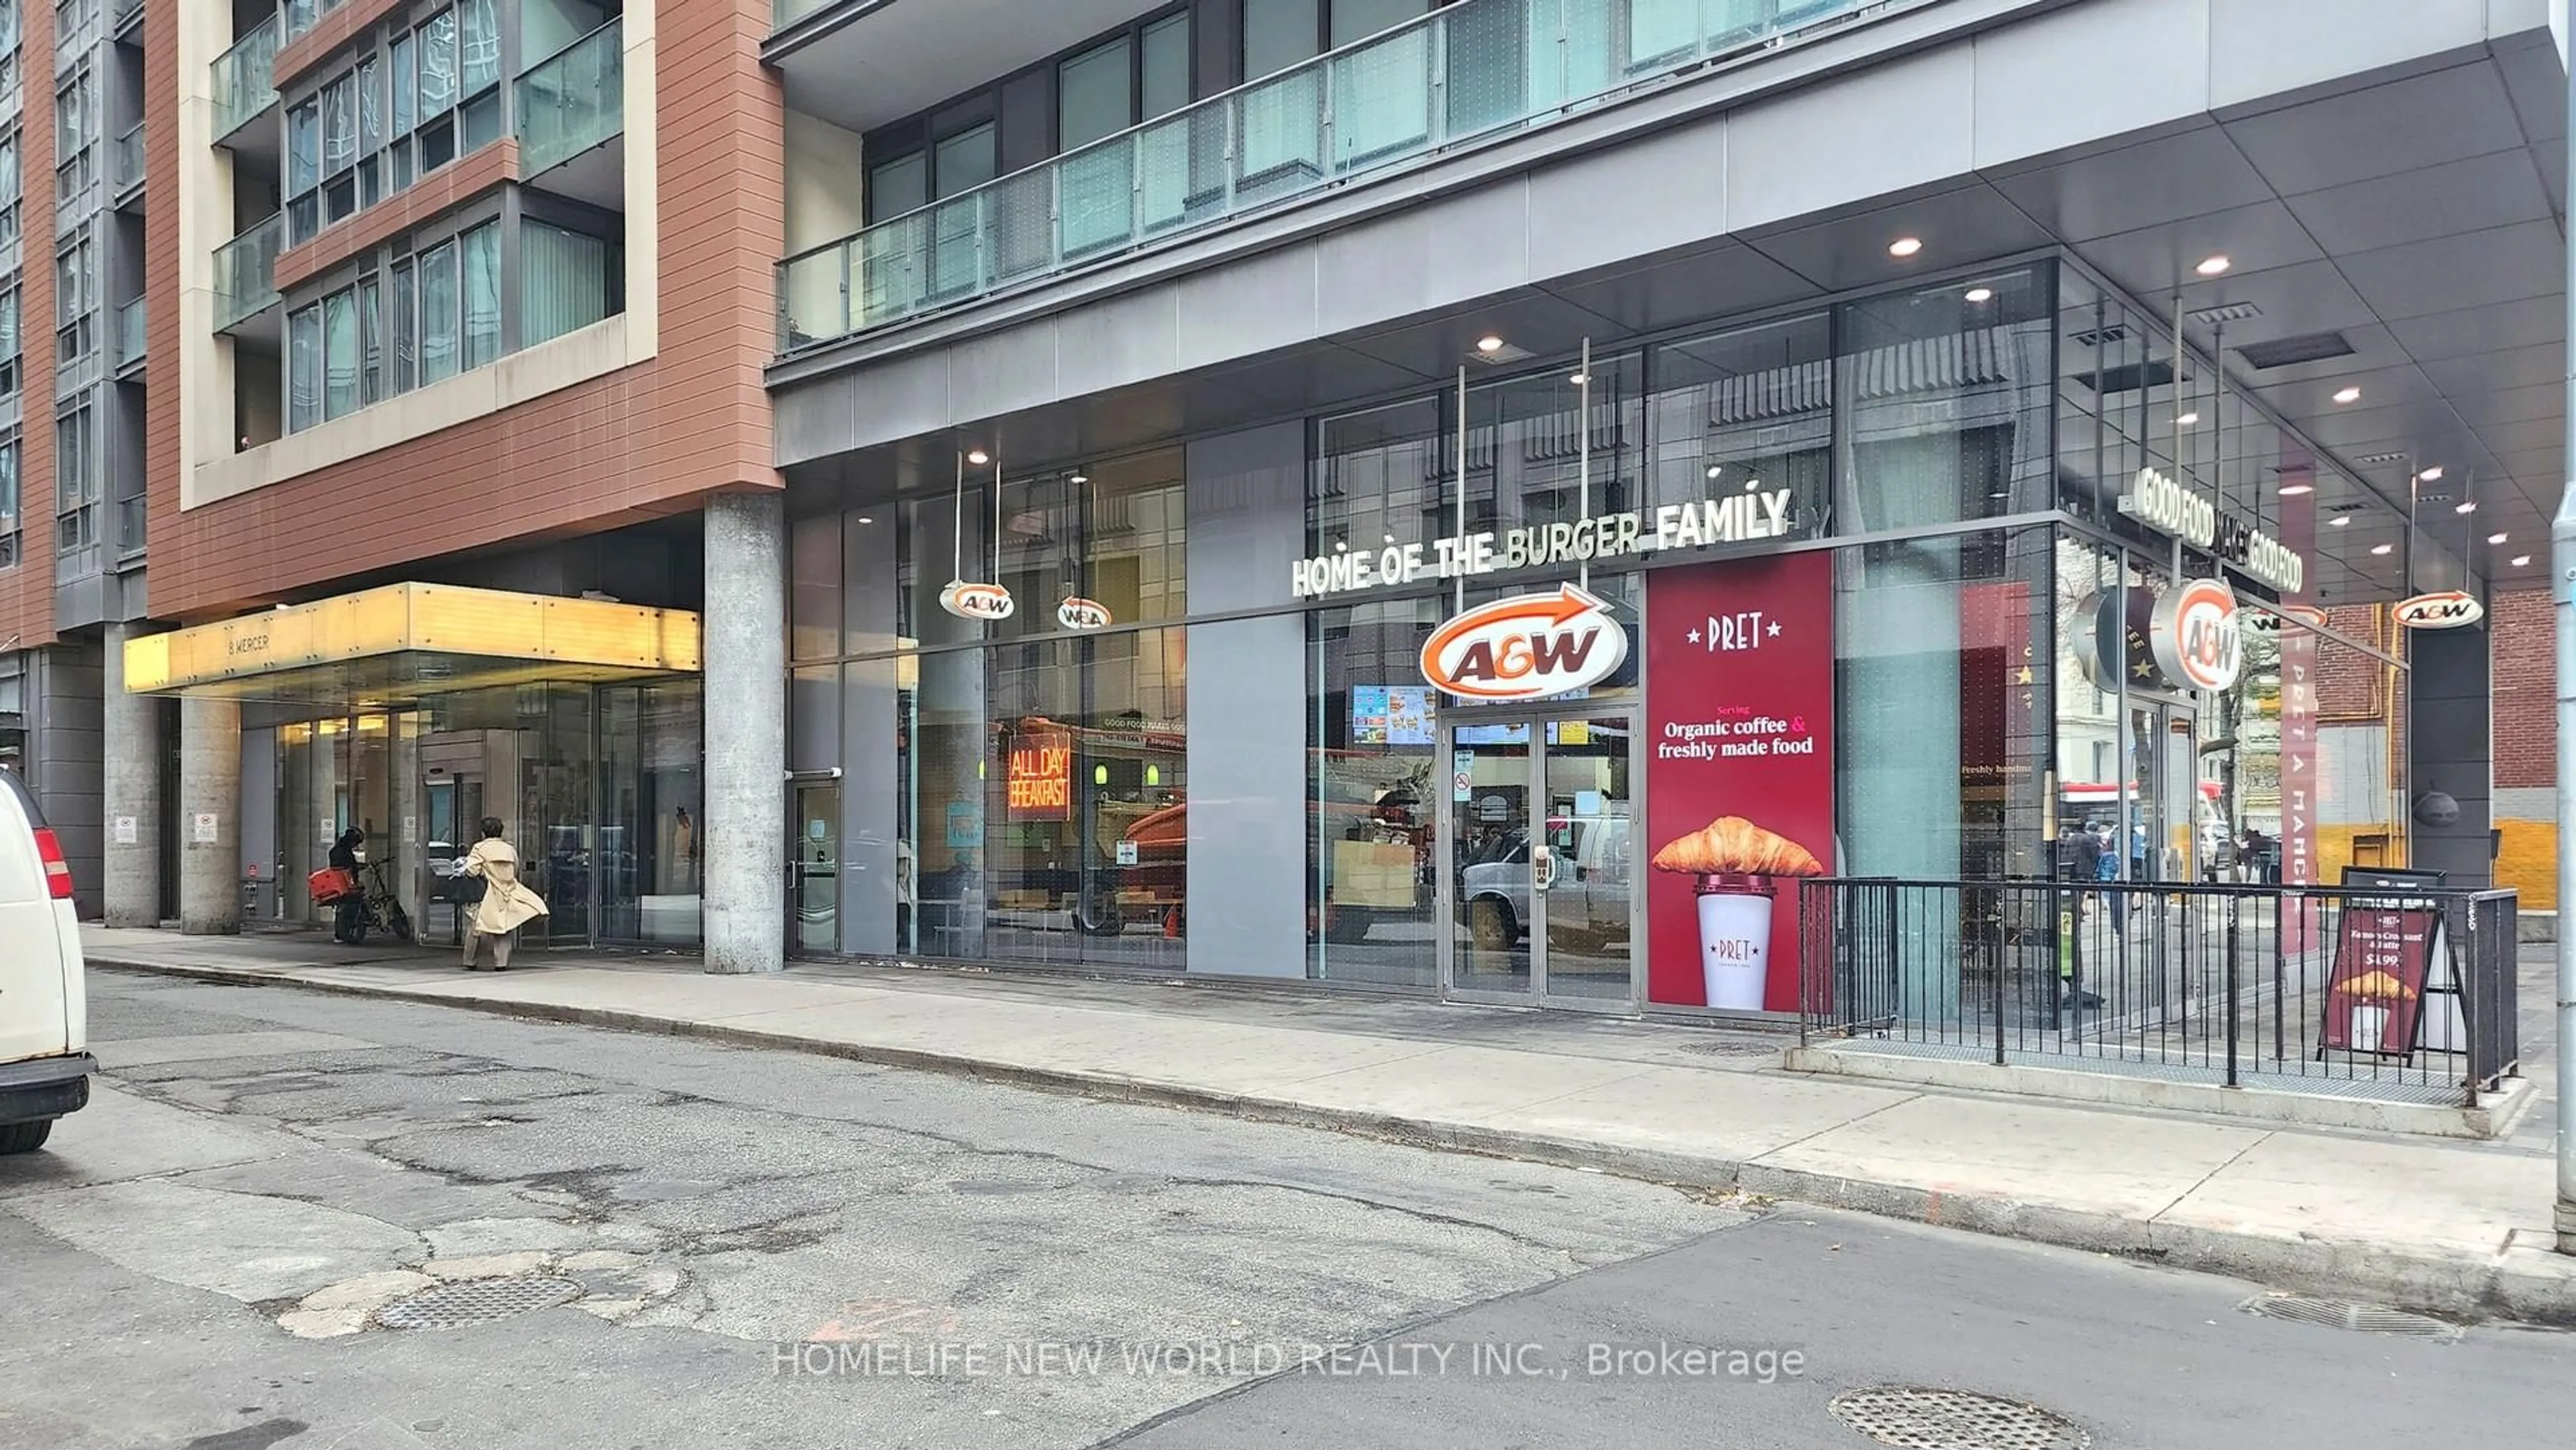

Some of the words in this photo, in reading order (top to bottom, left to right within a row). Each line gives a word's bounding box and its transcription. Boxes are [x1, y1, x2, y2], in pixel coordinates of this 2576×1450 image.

[2136, 467, 2181, 528] GOOD
[2182, 489, 2215, 547] FOOD
[1291, 550, 1372, 598] HOME
[1380, 542, 1424, 585] OF
[1433, 532, 1495, 579] THE
[1507, 512, 1643, 569] BURGER
[1656, 488, 1792, 551] FAMILY
[963, 596, 1010, 614] A&W
[2406, 604, 2472, 622] A&W
[235, 634, 270, 655] MERCER
[1708, 611, 1763, 653] PRET
[2186, 614, 2237, 673] A&W
[1448, 625, 1602, 683] A&W
[1717, 705, 1751, 716] Serving
[2292, 664, 2306, 741] PRET
[1664, 720, 1731, 741] Organic
[1733, 716, 1788, 735] coffee
[1791, 715, 1807, 732] &
[1658, 740, 1718, 761] freshly
[1721, 738, 1769, 757] made
[1772, 736, 1814, 755] food
[1011, 750, 1039, 777] ALL
[1040, 747, 1068, 779] DAY
[1010, 779, 1069, 807] BREAKFAST
[1719, 939, 1750, 960] PRET
